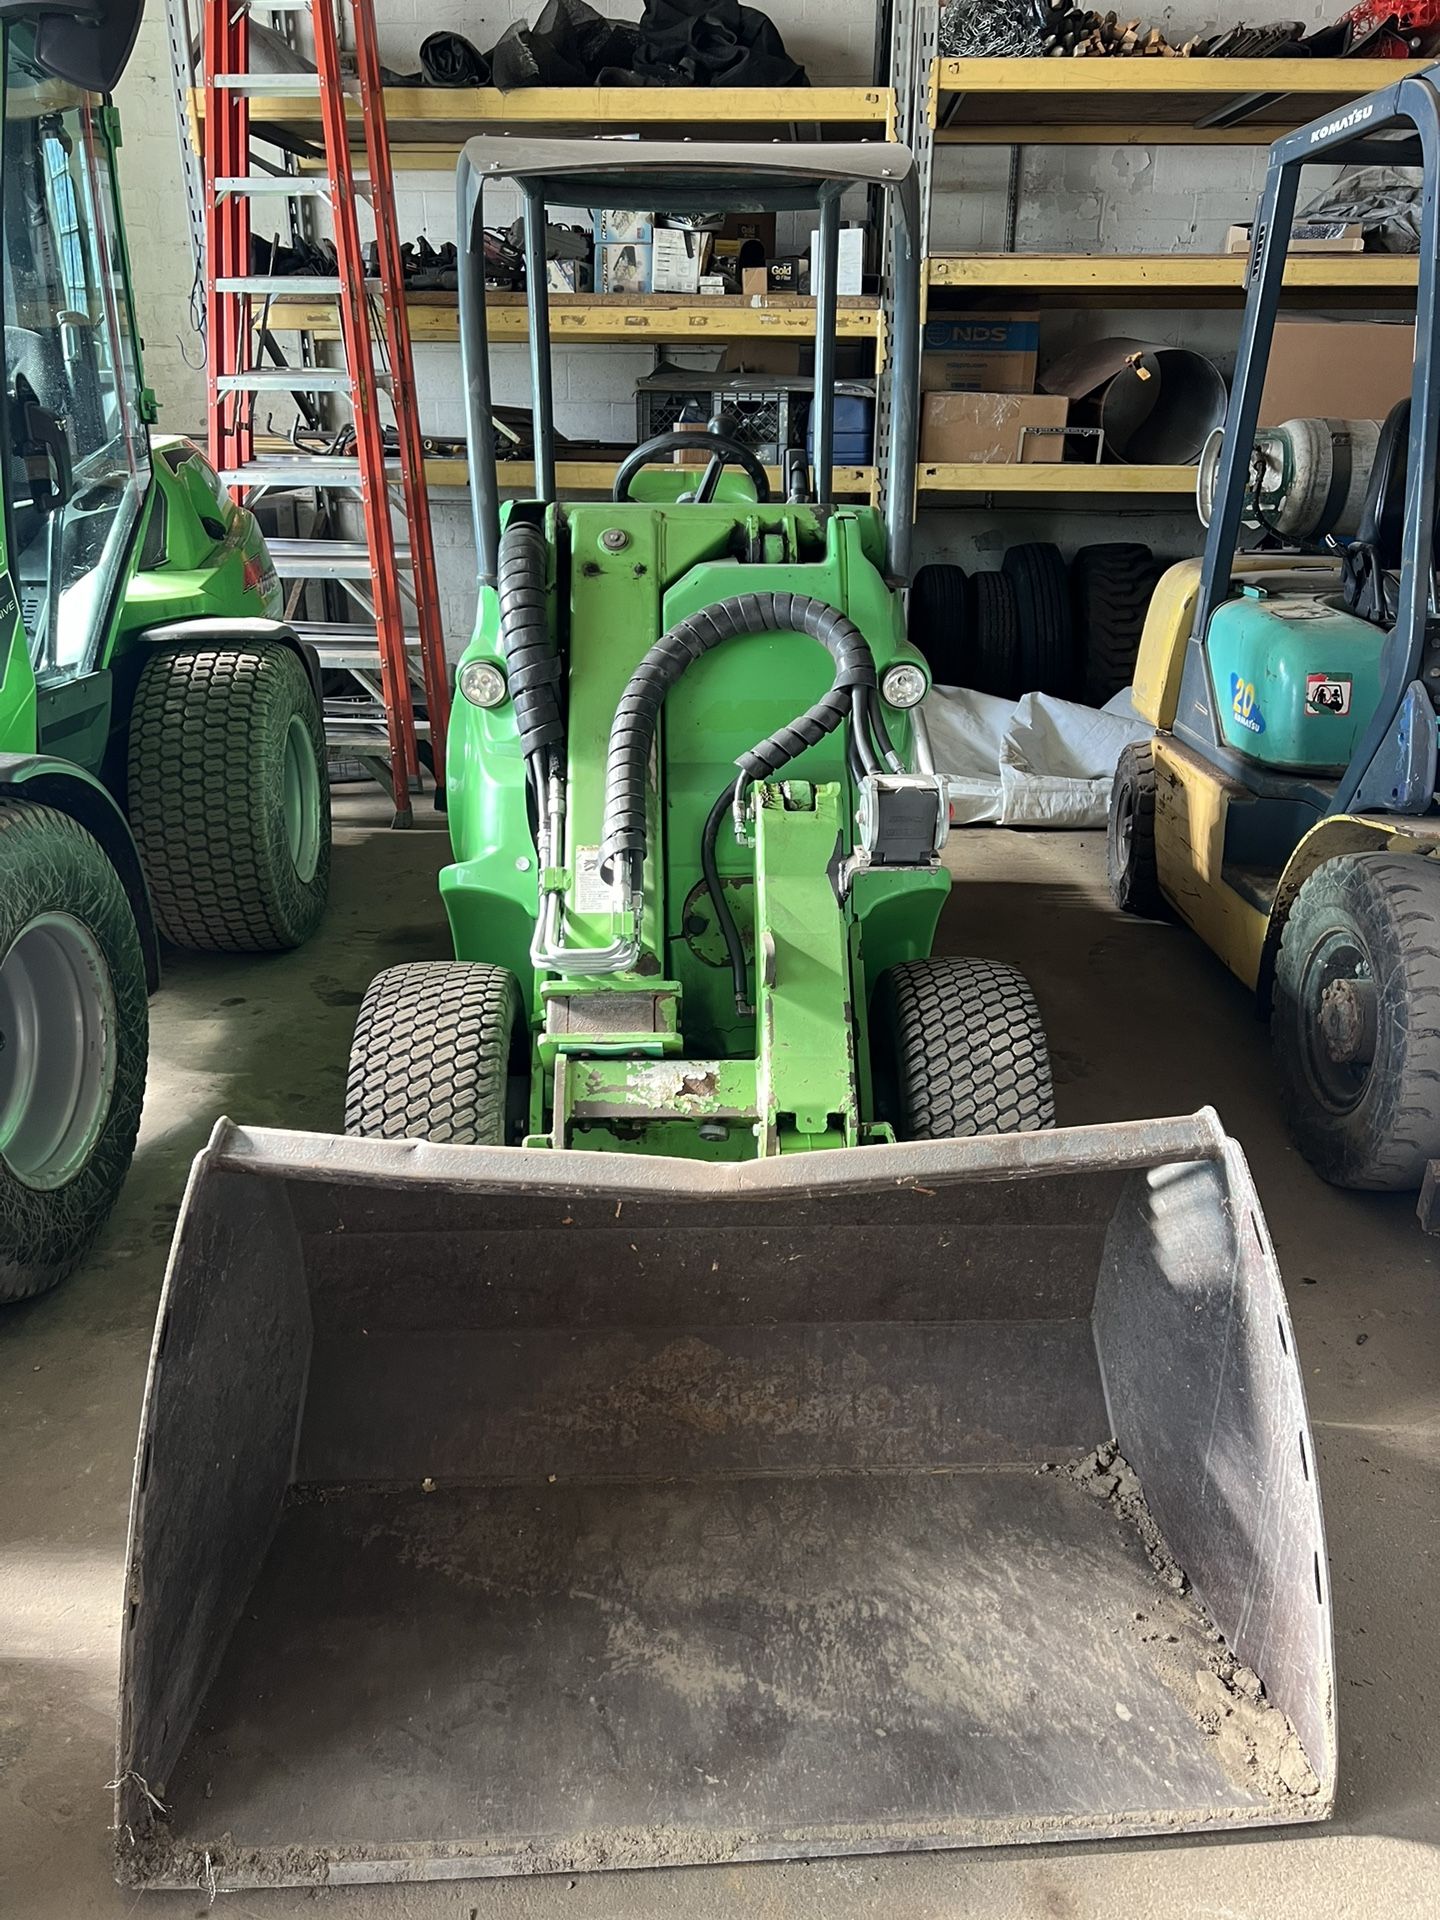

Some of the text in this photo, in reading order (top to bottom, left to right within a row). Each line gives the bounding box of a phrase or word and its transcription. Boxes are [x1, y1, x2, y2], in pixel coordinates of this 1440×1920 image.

[1310, 104, 1373, 143] KOMATSU
[771, 265, 792, 275] Gold
[952, 327, 1008, 341] NDS
[1233, 677, 1255, 718] 20
[1234, 712, 1260, 732] KOMATSU
